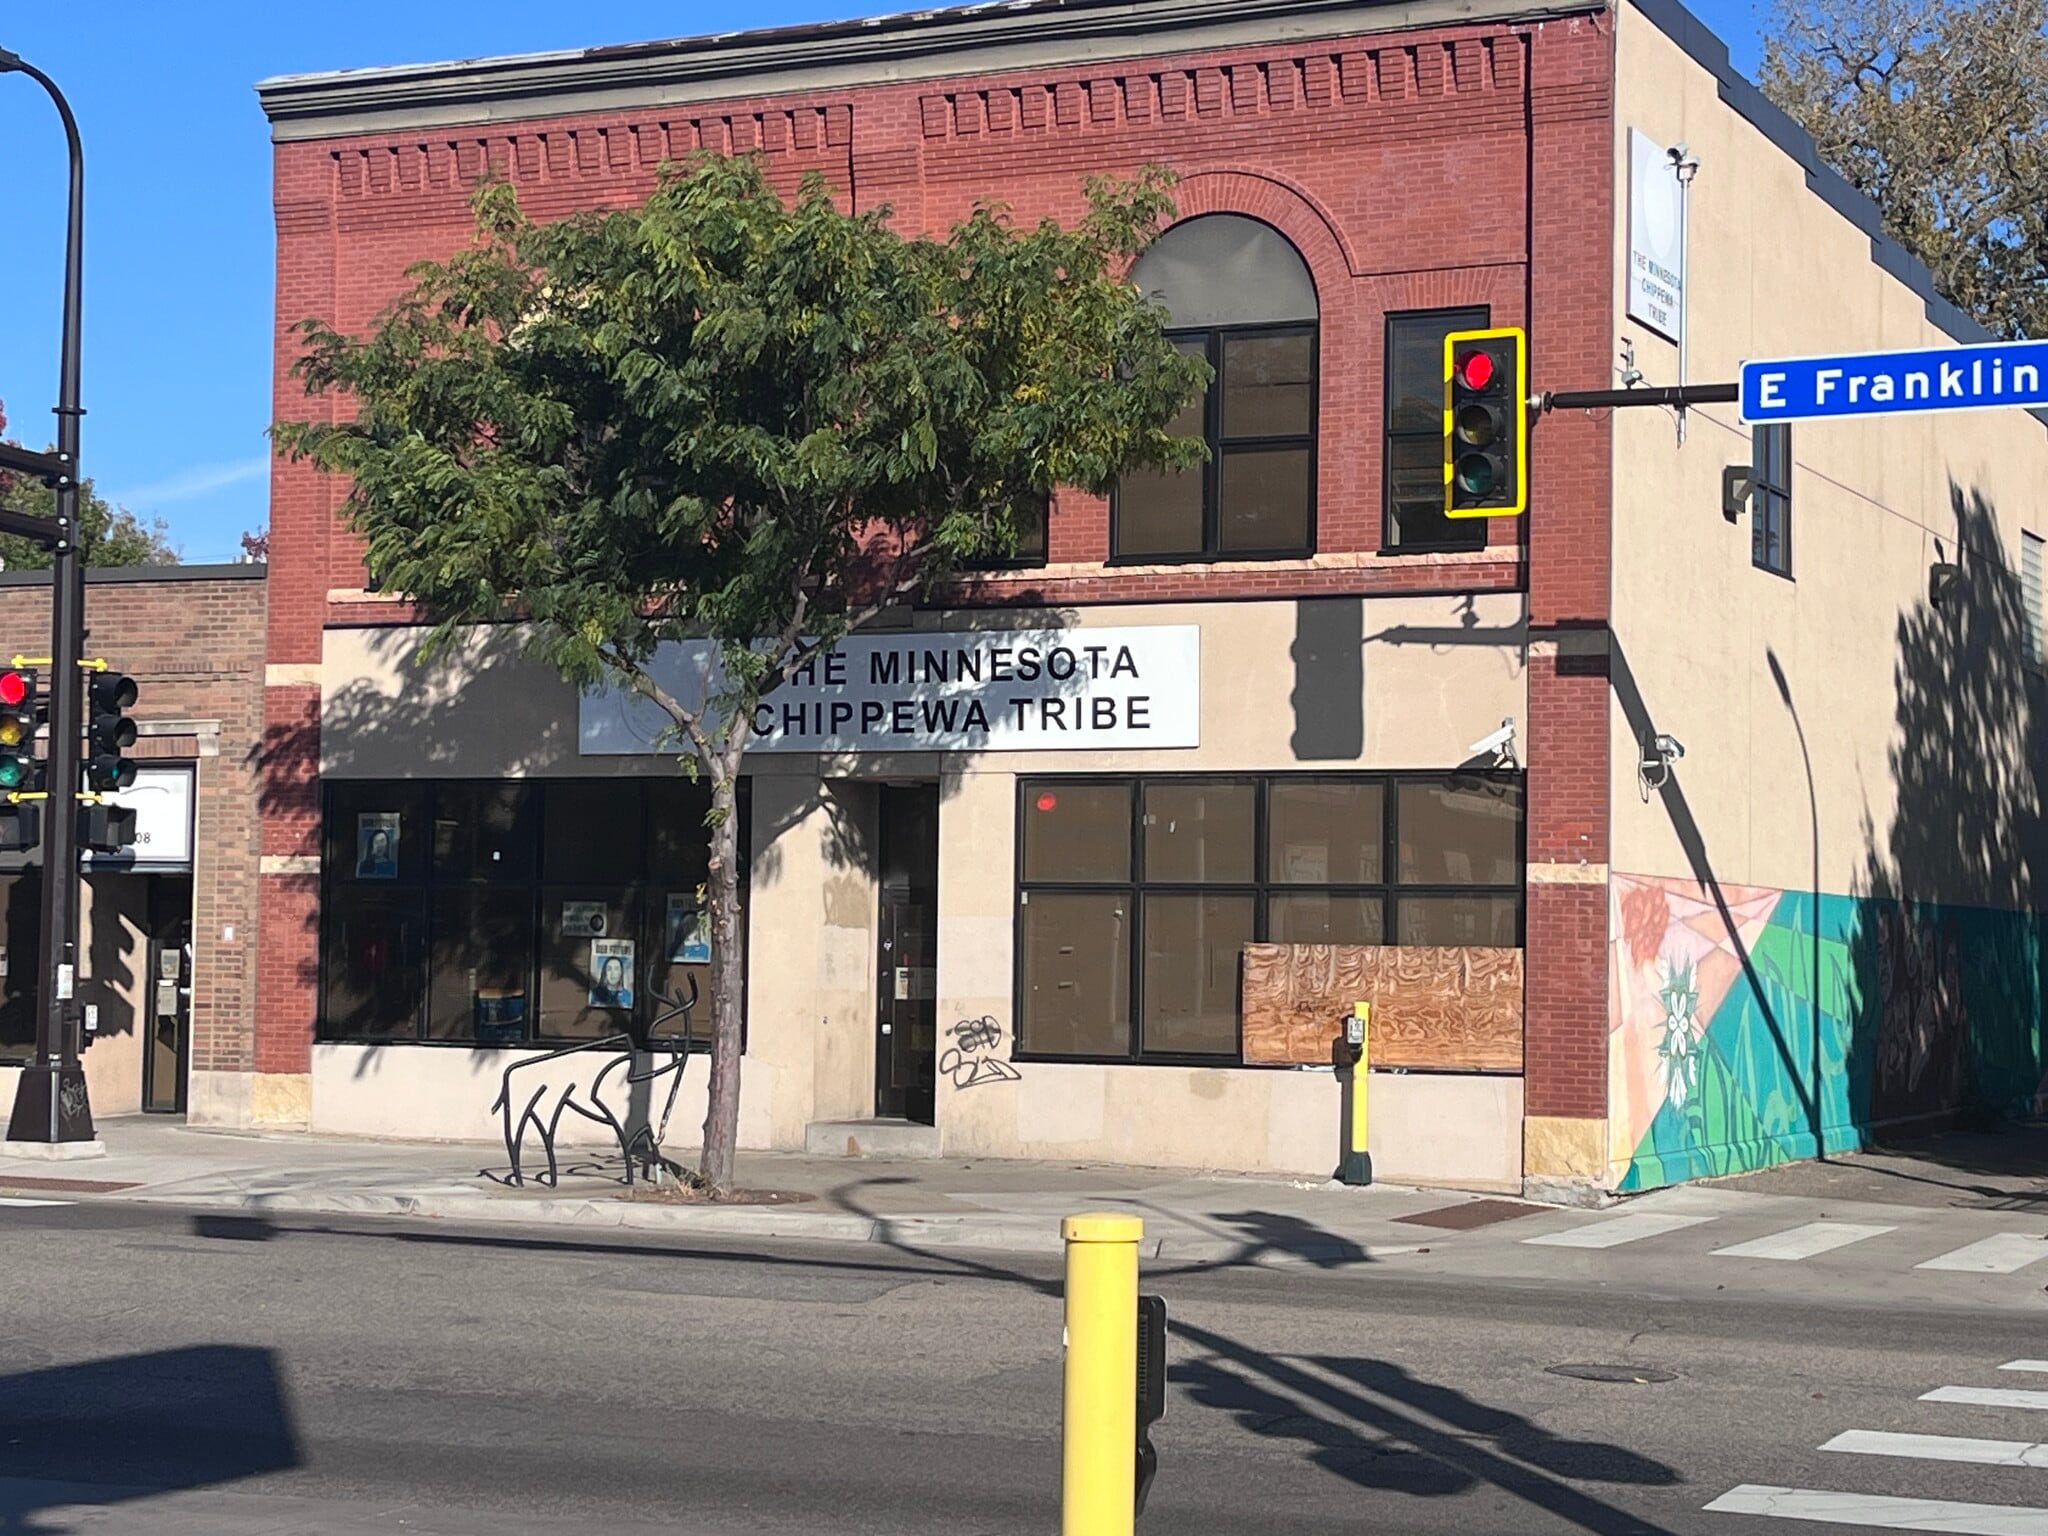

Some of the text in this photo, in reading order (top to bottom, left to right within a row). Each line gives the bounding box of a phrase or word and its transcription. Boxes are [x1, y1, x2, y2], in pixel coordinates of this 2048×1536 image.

[1632, 250, 1646, 271] THE
[1647, 303, 1667, 327] TRIBE
[1760, 357, 2040, 408] E Franklin
[780, 645, 1140, 687] HE MINNESOTA
[751, 695, 1151, 737] CHIPPEWA TRIBE
